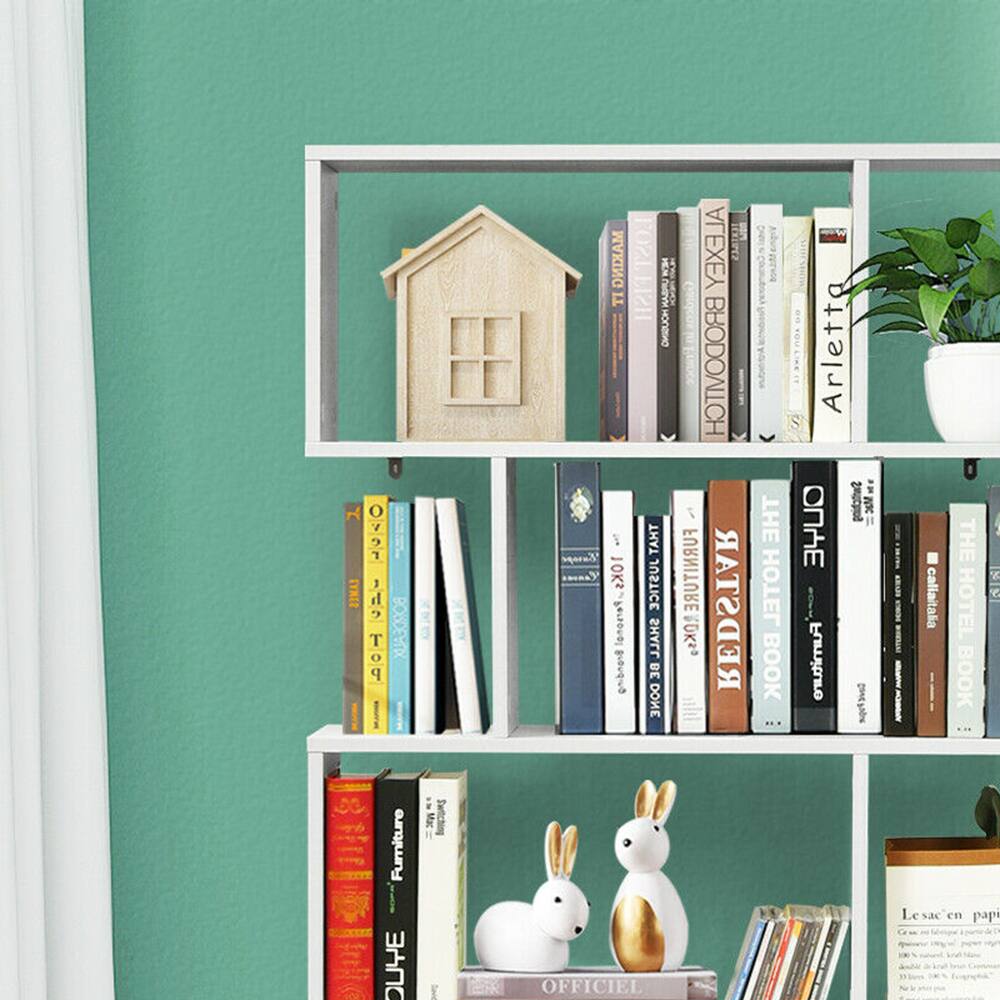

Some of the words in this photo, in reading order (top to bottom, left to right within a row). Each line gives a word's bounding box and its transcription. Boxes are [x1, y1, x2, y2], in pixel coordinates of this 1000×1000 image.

[821, 283, 843, 413] Arletta
[958, 518, 976, 562] THE
[957, 568, 976, 644] HOTEL
[957, 646, 974, 708] BOOK
[436, 800, 446, 835] Switching
[391, 809, 403, 881] Furniture
[903, 908, 918, 920] Le
[922, 911, 940, 919] sac
[947, 911, 962, 919] en
[542, 978, 642, 994] OFFICIEL
